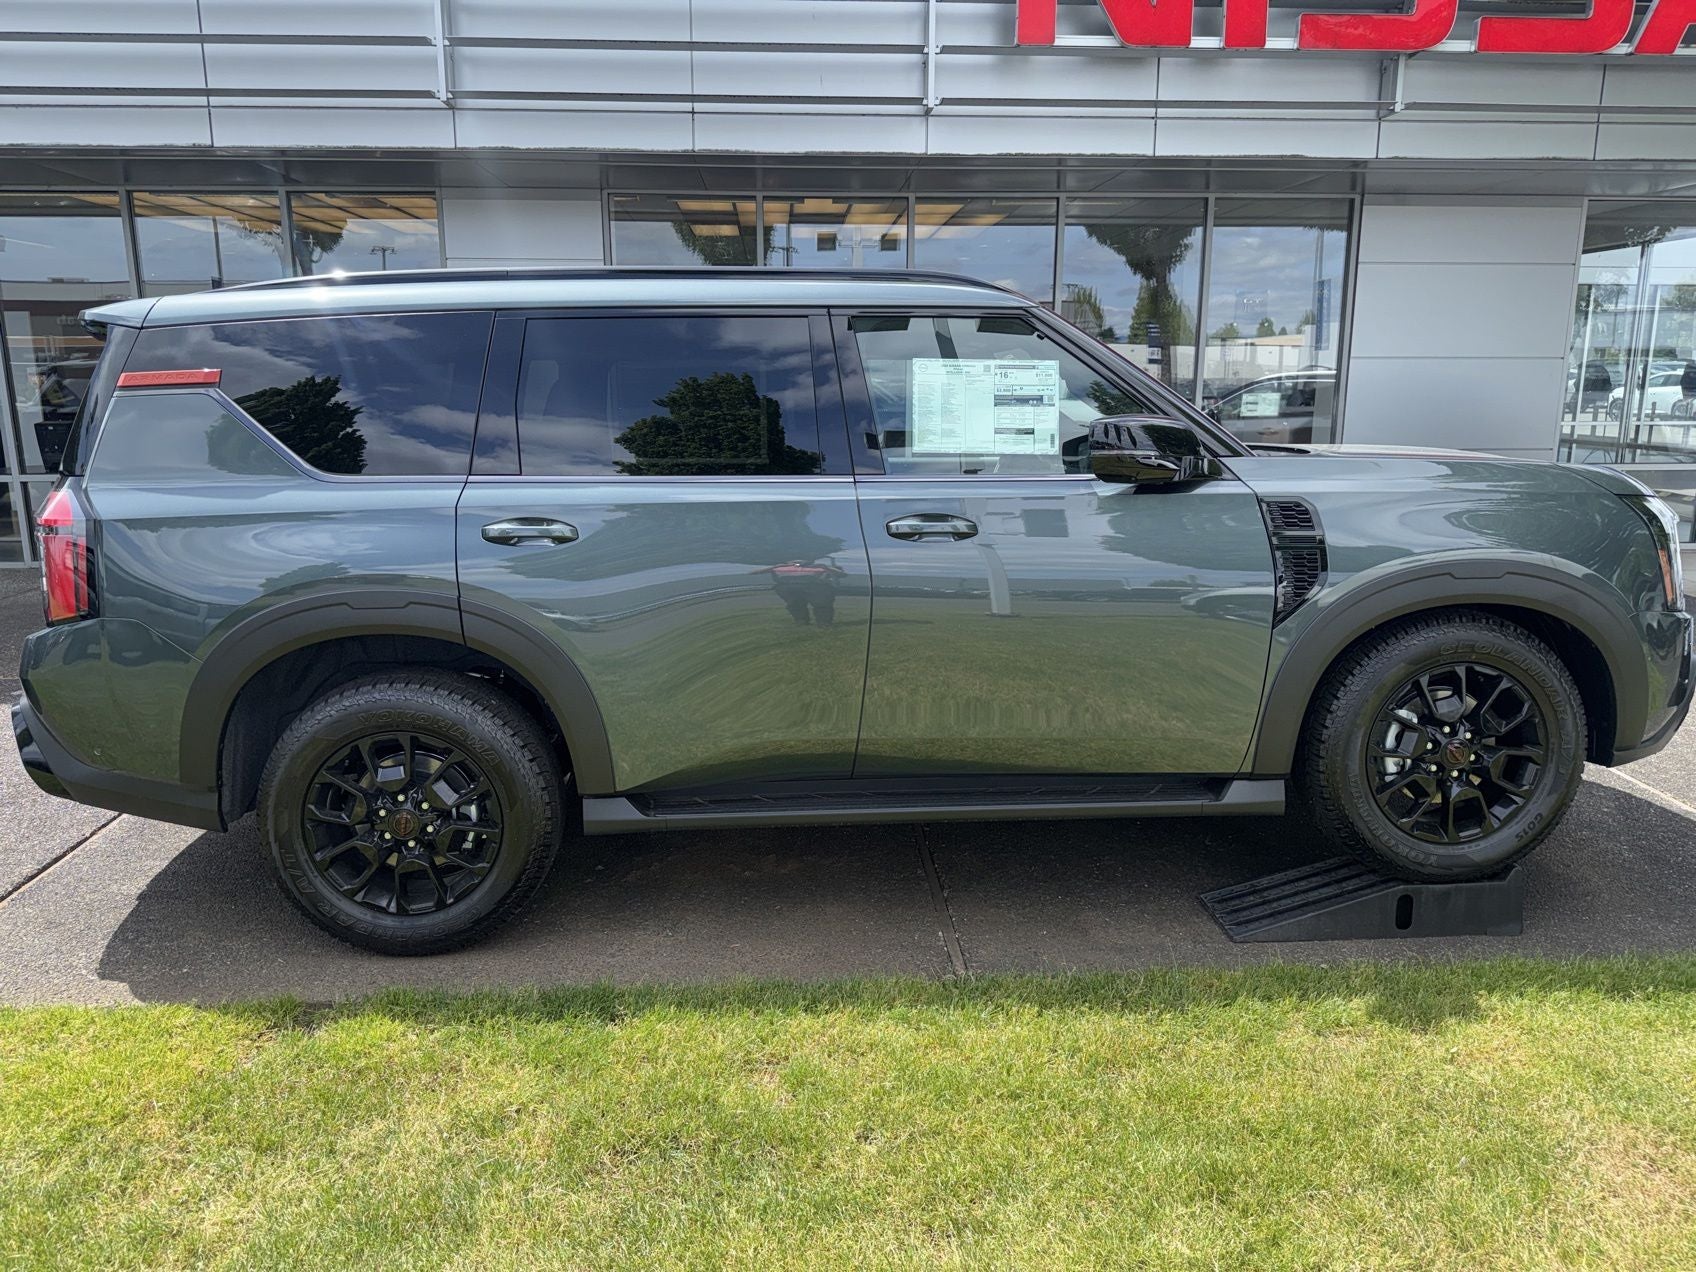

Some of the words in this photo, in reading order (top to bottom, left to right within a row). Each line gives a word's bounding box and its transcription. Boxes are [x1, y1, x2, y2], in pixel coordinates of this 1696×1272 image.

[126, 372, 198, 385] ARMADA
[1440, 640, 1570, 720] GEOLANDAR
[359, 709, 501, 765] YOKOHAMA
[1348, 773, 1440, 866] YOKOHAMA
[1514, 812, 1544, 842] G015
